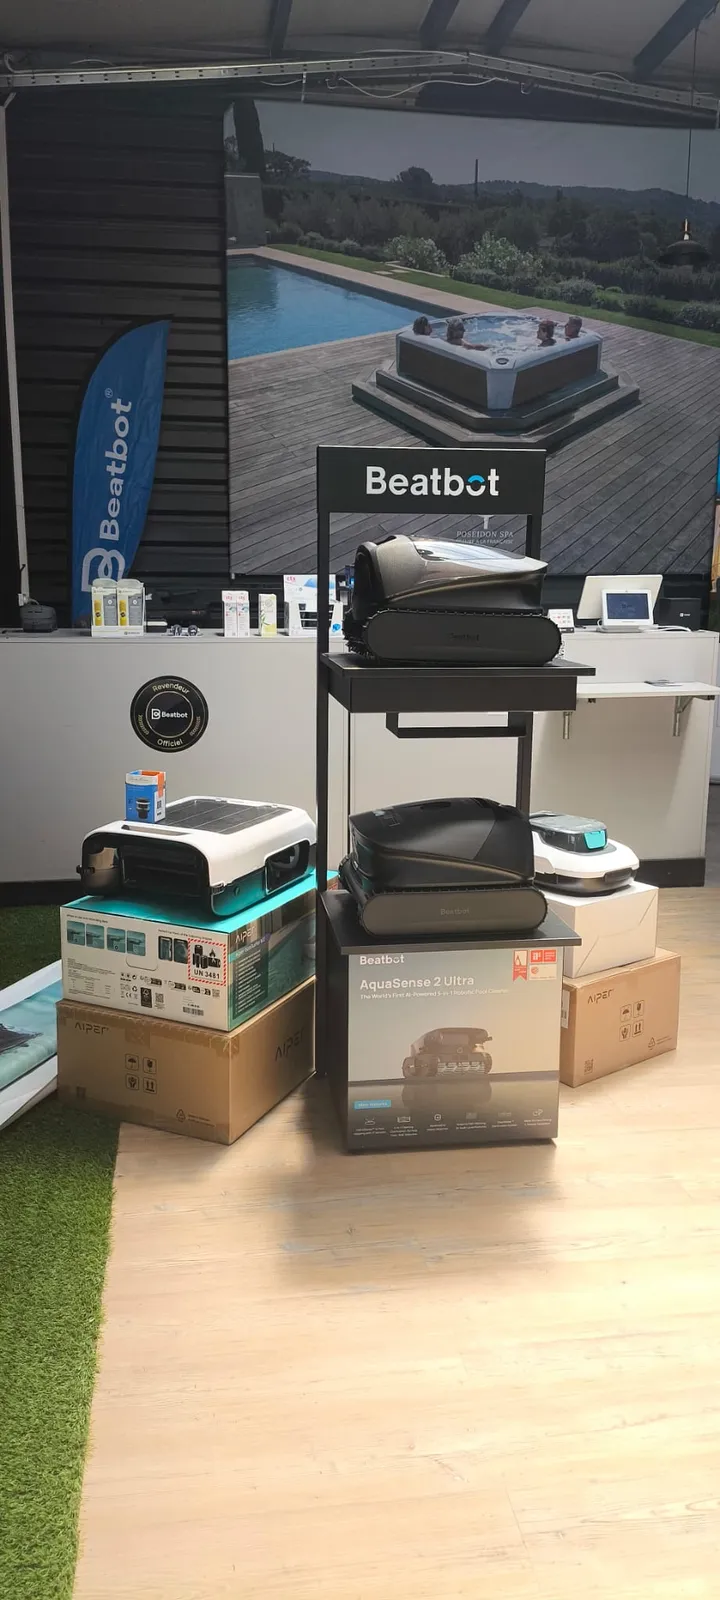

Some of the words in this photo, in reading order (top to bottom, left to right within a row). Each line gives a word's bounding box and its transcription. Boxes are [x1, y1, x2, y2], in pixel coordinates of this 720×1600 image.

[366, 466, 499, 496] Beatbot
[152, 683, 190, 694] Revendeur
[157, 738, 183, 747] Officiel
[440, 906, 470, 915] Beatbot
[359, 954, 404, 965] Beatbot
[205, 971, 220, 979] 3481
[360, 978, 431, 992] AquaSense
[433, 976, 441, 987] 2
[444, 975, 474, 987] Ultra
